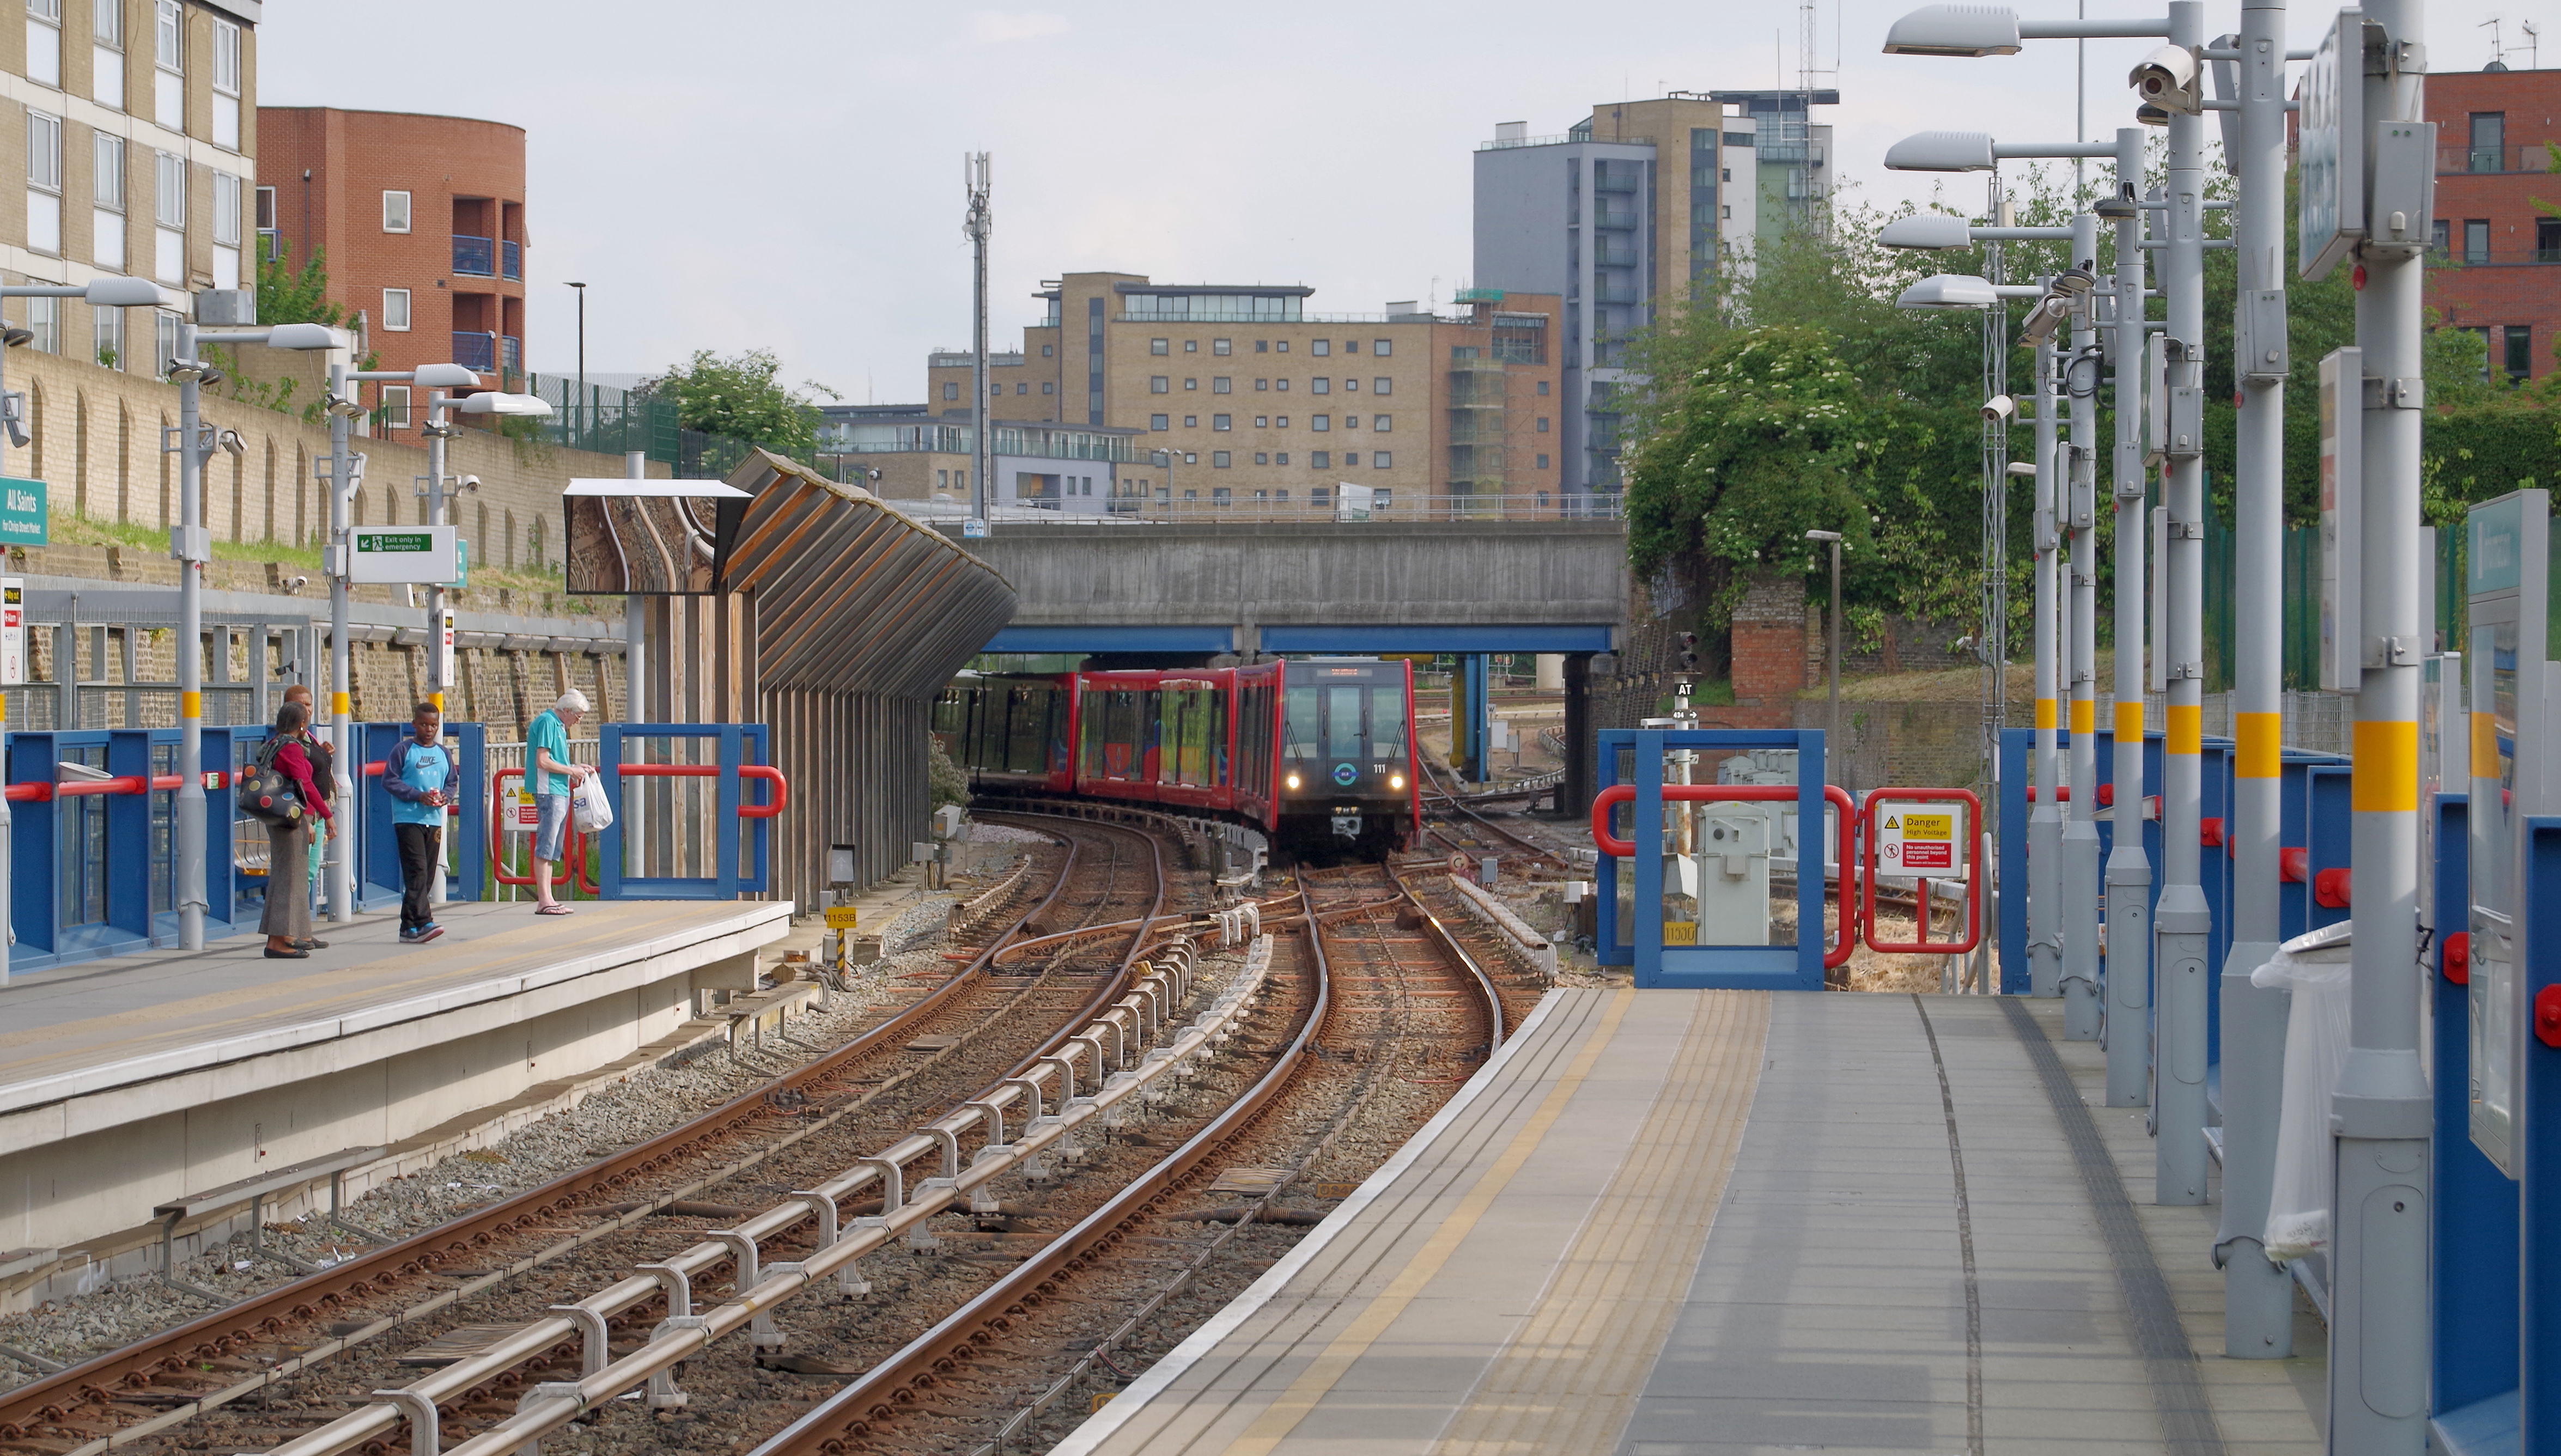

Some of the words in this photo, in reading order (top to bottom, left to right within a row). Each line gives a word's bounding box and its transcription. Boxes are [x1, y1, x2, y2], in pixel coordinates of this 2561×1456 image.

[7, 488, 16, 510] All
[17, 489, 37, 513] Saints
[1678, 684, 1692, 695] AT
[1373, 764, 1386, 773] 111
[1907, 818, 1940, 827] Danger
[828, 913, 856, 922] 1153B
